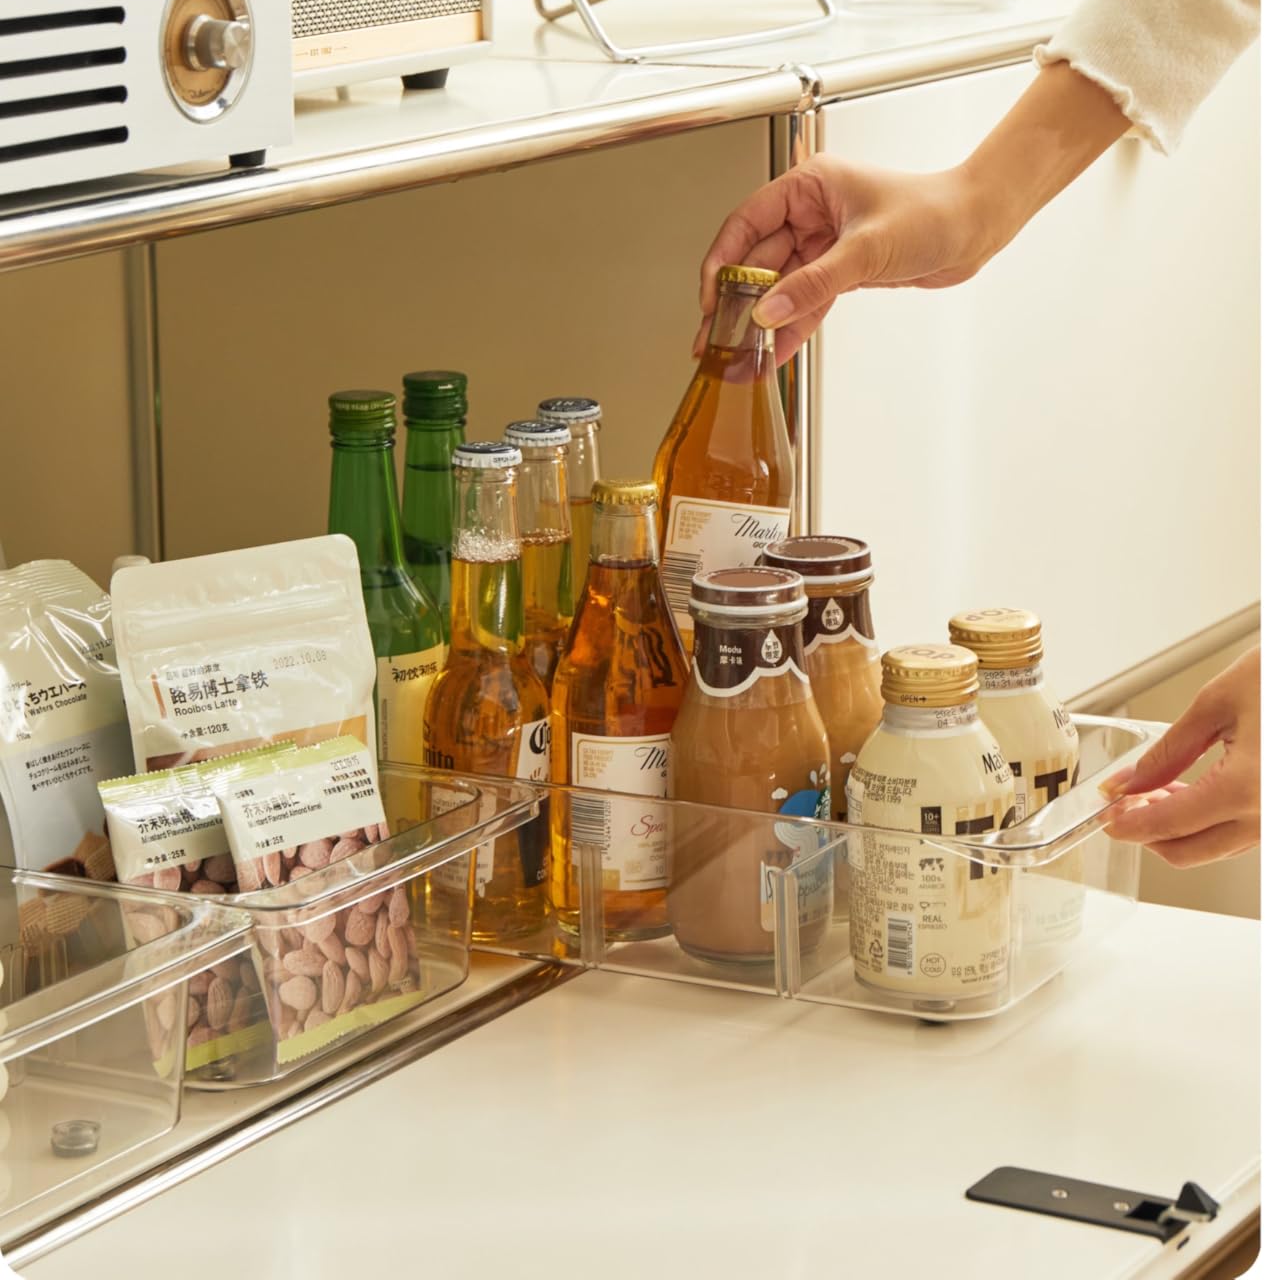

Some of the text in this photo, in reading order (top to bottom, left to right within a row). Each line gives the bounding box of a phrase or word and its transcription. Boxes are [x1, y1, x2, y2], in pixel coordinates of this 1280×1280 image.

[719, 645, 742, 654] Mocha
[169, 670, 270, 705] 路易博士拿铁
[174, 702, 213, 717] Rooibos
